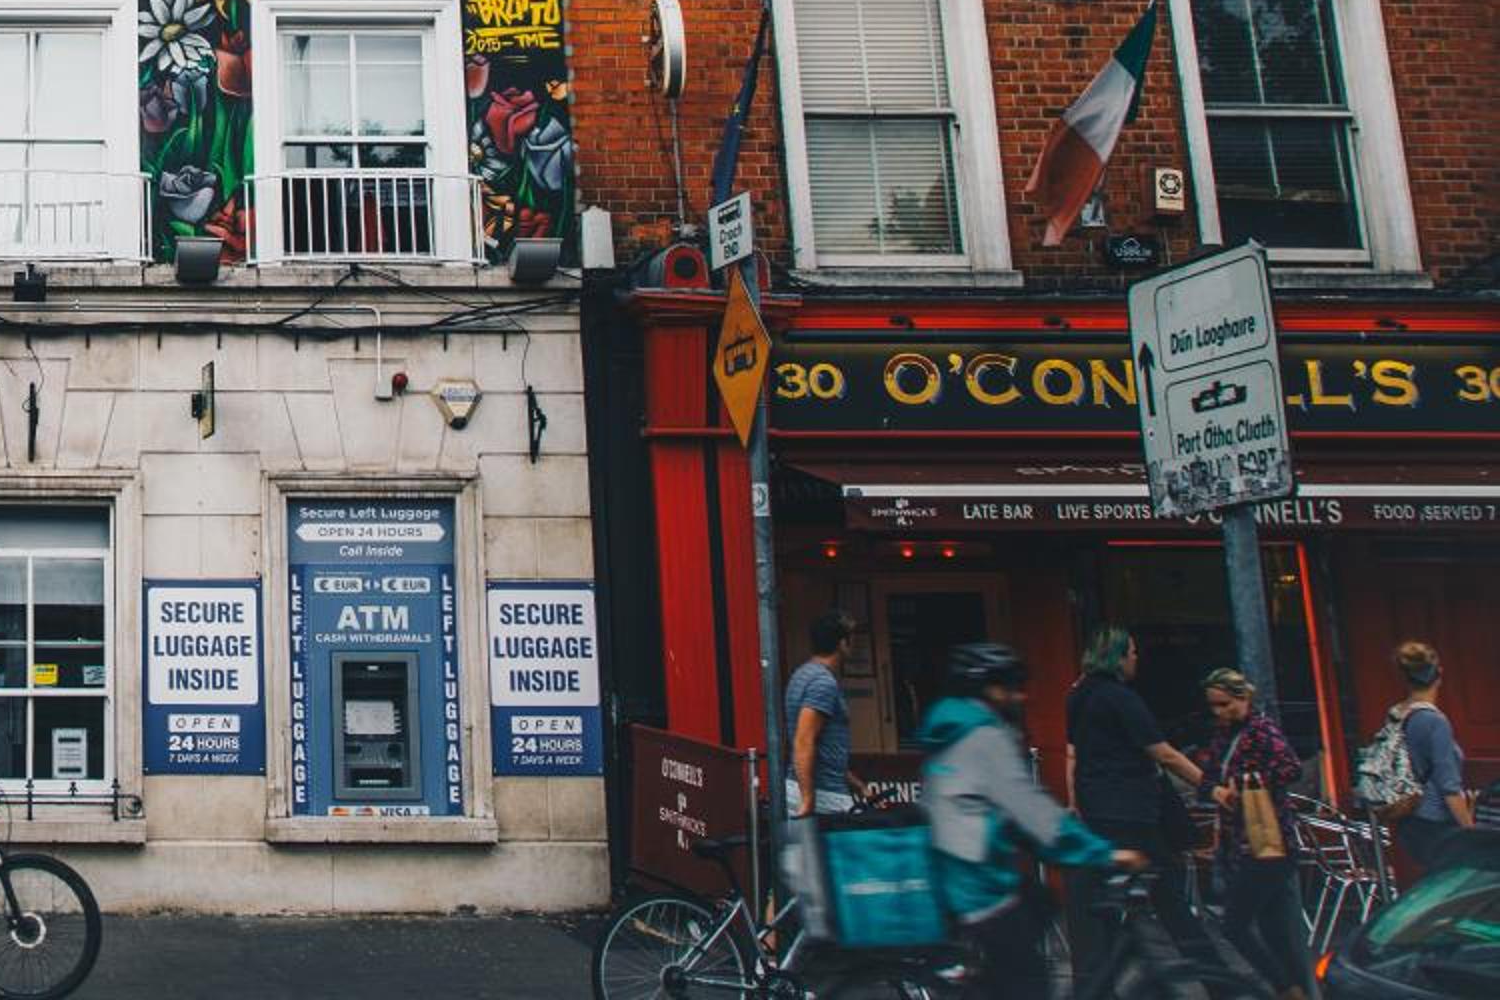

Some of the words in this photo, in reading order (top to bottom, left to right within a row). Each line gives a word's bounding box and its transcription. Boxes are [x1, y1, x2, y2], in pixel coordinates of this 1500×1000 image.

[1170, 328, 1192, 355] Dún
[1196, 315, 1256, 348] Laoghaire
[774, 363, 845, 398] 30
[884, 353, 1417, 405] O'CONL'S
[1177, 430, 1202, 455] Port
[300, 508, 345, 519] Secure
[350, 507, 376, 519] Left
[381, 507, 440, 521] Luggage
[963, 504, 998, 519] LATE
[1003, 504, 1033, 519] BAR
[1057, 504, 1089, 519] LIVE
[1094, 504, 1151, 519] SPORTS
[1373, 505, 1415, 519] FOOD
[318, 527, 354, 537] OPEN
[358, 527, 373, 537] 24
[377, 527, 423, 537] HOURS
[339, 545, 363, 557] Call
[366, 545, 403, 557] Inside
[334, 579, 359, 590] EUR
[403, 579, 427, 590] EUR
[161, 602, 244, 623] SECURE
[291, 574, 303, 651] LEFT
[337, 605, 409, 631] ATM
[442, 574, 454, 652] LEFT
[500, 603, 583, 625] SECURE
[153, 635, 253, 657] LUGGAGE
[315, 633, 346, 643] CASH
[350, 633, 432, 643] WITHDRAWALS
[494, 637, 593, 659] LUGGAGE
[168, 668, 239, 690] INSIDE
[510, 670, 580, 692] INSIDE
[175, 718, 232, 729] OPEN
[519, 719, 575, 731] OPEN
[292, 661, 307, 803] LUGGAGE
[445, 661, 461, 803] LUGGAGE
[169, 735, 194, 751] 24
[197, 736, 240, 750] HOURS
[512, 737, 537, 753] 24
[539, 738, 582, 752] HOURS
[169, 753, 175, 763] 7
[177, 753, 201, 763] DAYS
[203, 753, 210, 763] A
[212, 753, 239, 763] WEEK
[512, 755, 519, 765] 7
[520, 755, 545, 765] DAYS
[546, 755, 553, 765] A
[555, 755, 582, 765] WEEK
